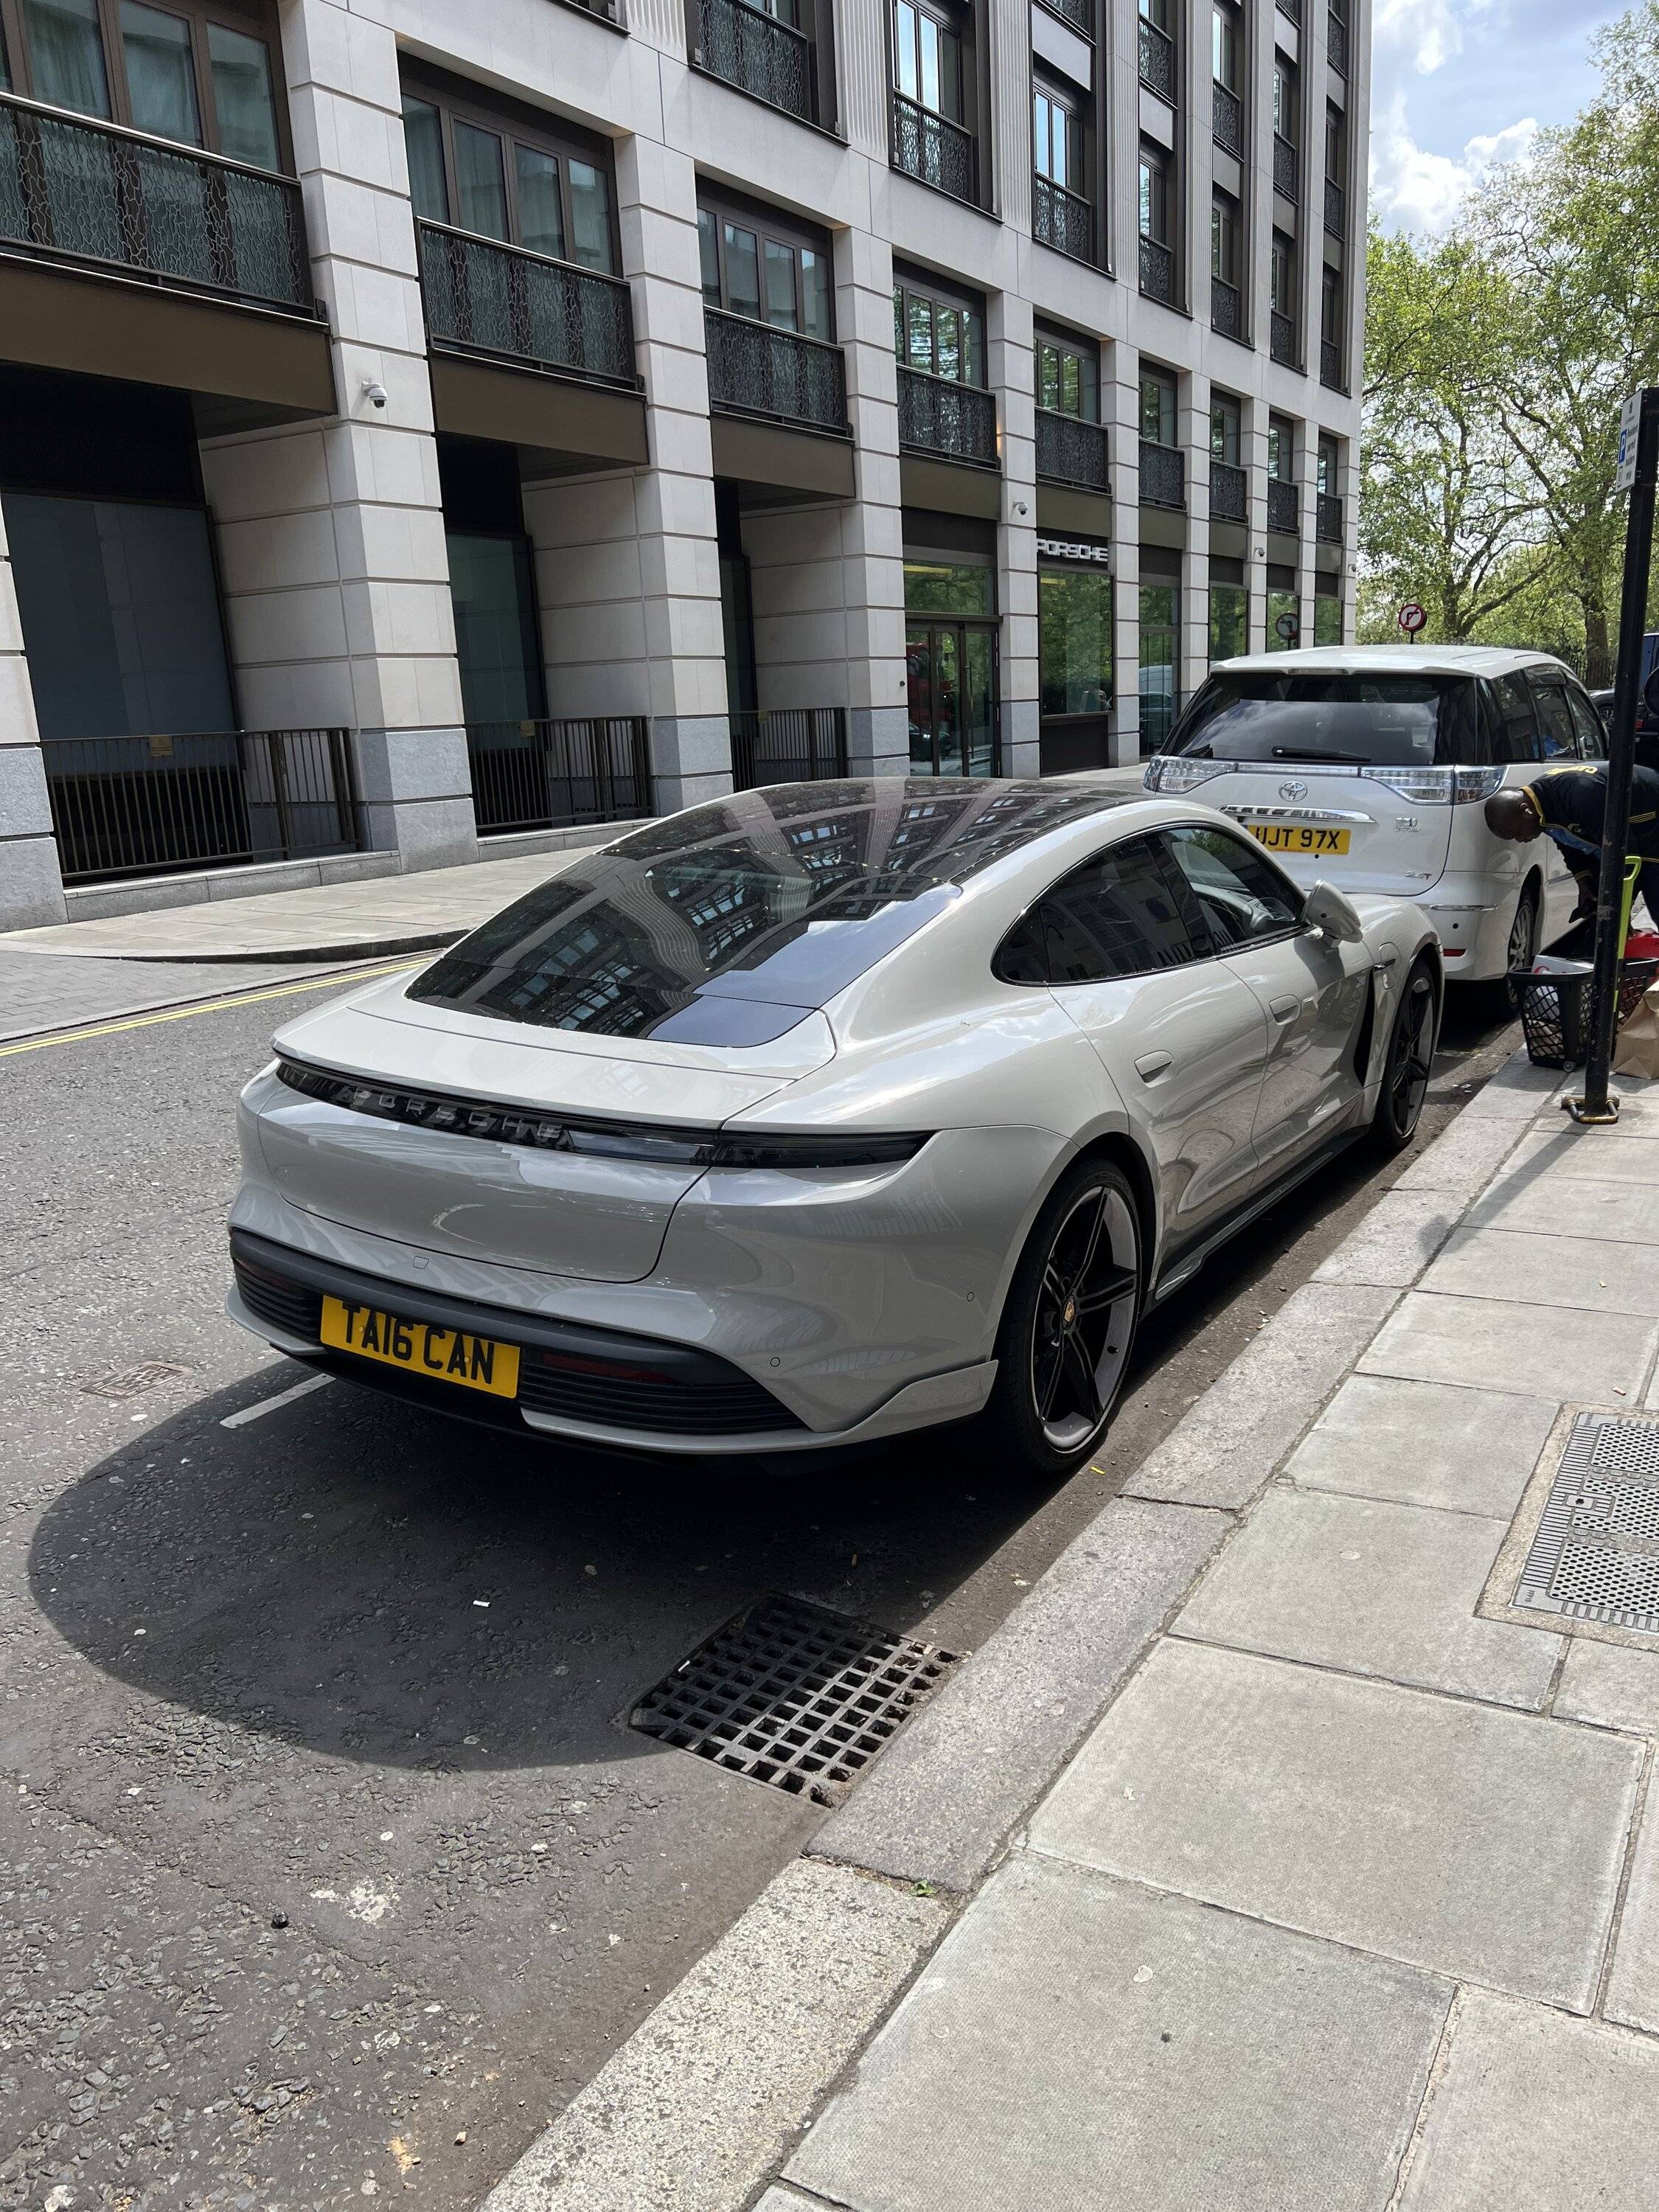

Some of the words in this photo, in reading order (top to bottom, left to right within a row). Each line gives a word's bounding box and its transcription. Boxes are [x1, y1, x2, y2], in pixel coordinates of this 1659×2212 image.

[1037, 538, 1108, 562] PORSCHE
[1256, 827, 1293, 846] UJT
[1301, 829, 1340, 849] 97X
[353, 1087, 563, 1139] PORSCHE
[342, 1301, 414, 1361] TA16
[423, 1326, 495, 1385] CAN
